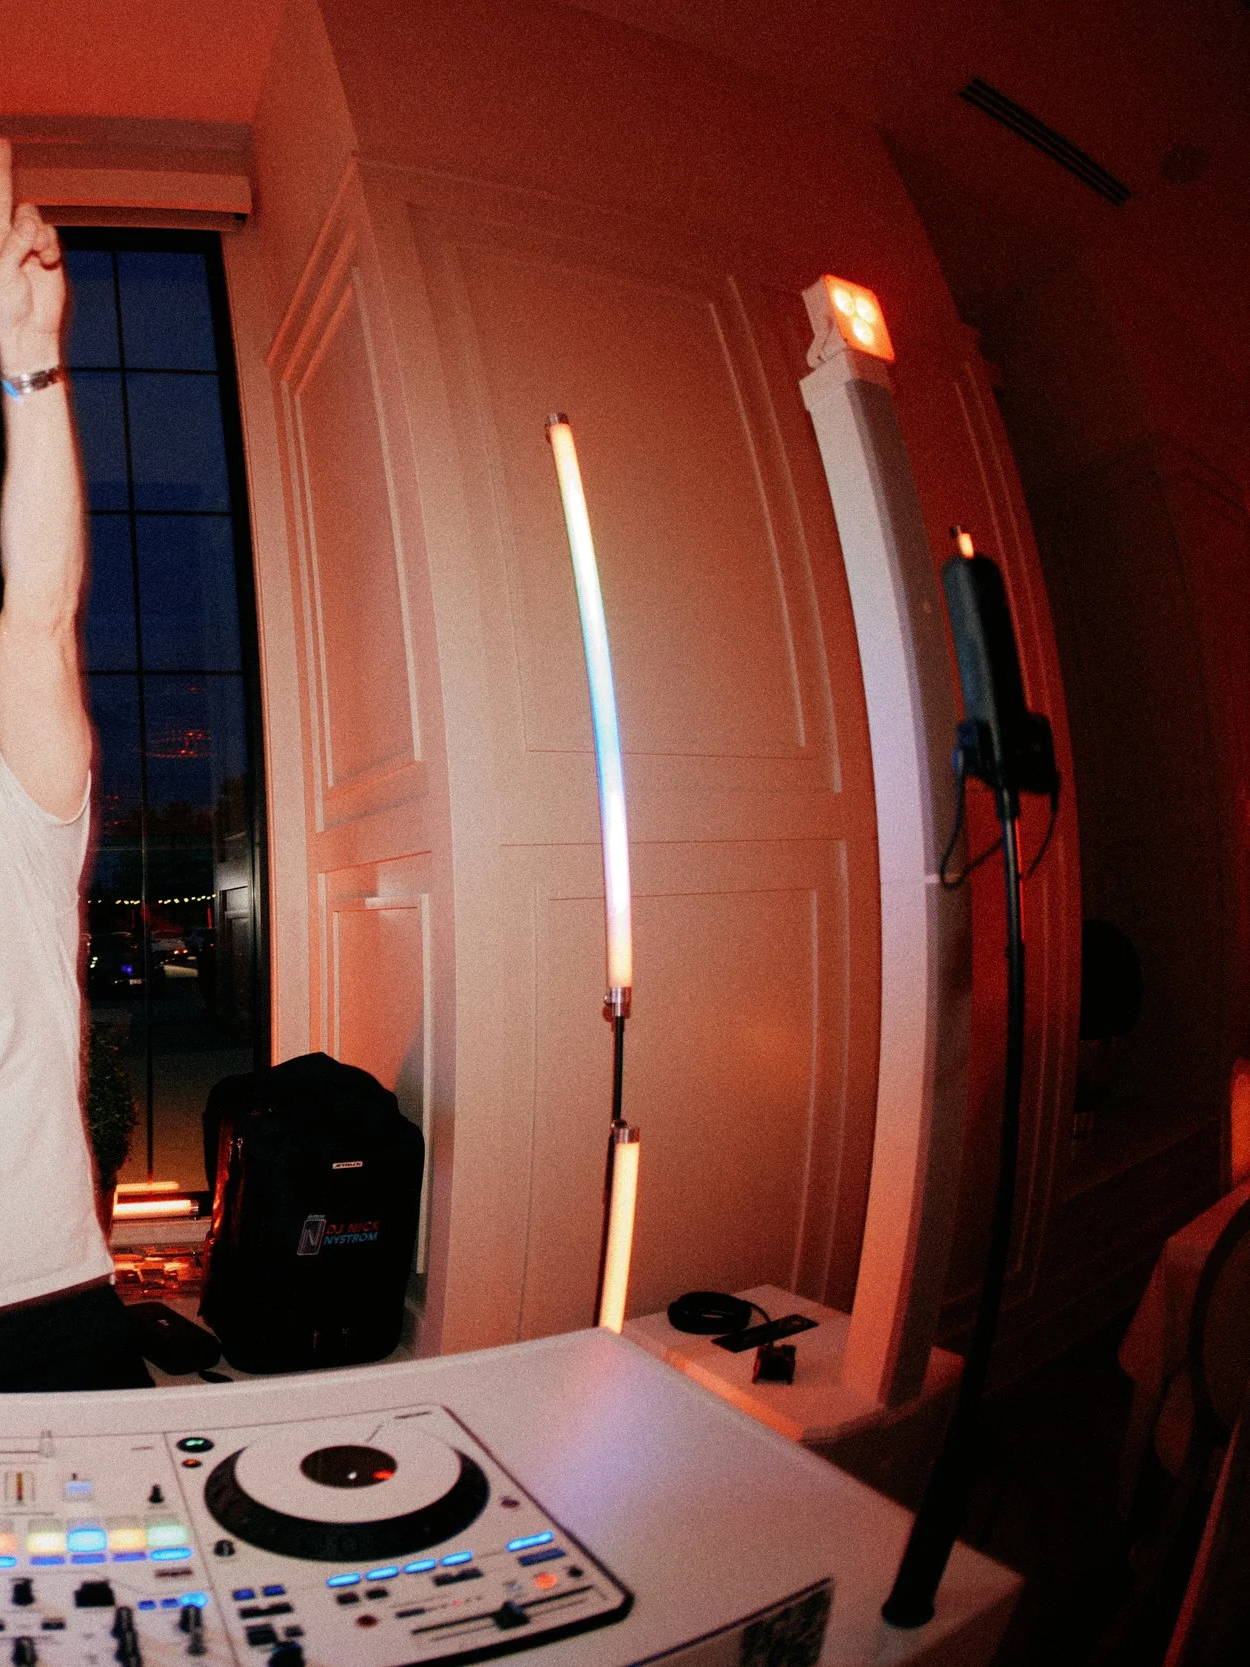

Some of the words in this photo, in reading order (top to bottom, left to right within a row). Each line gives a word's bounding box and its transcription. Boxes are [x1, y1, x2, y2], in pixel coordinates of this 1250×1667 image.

[326, 1224, 344, 1234] DJ
[348, 1221, 381, 1232] NICK
[324, 1232, 378, 1245] NYSTROM
